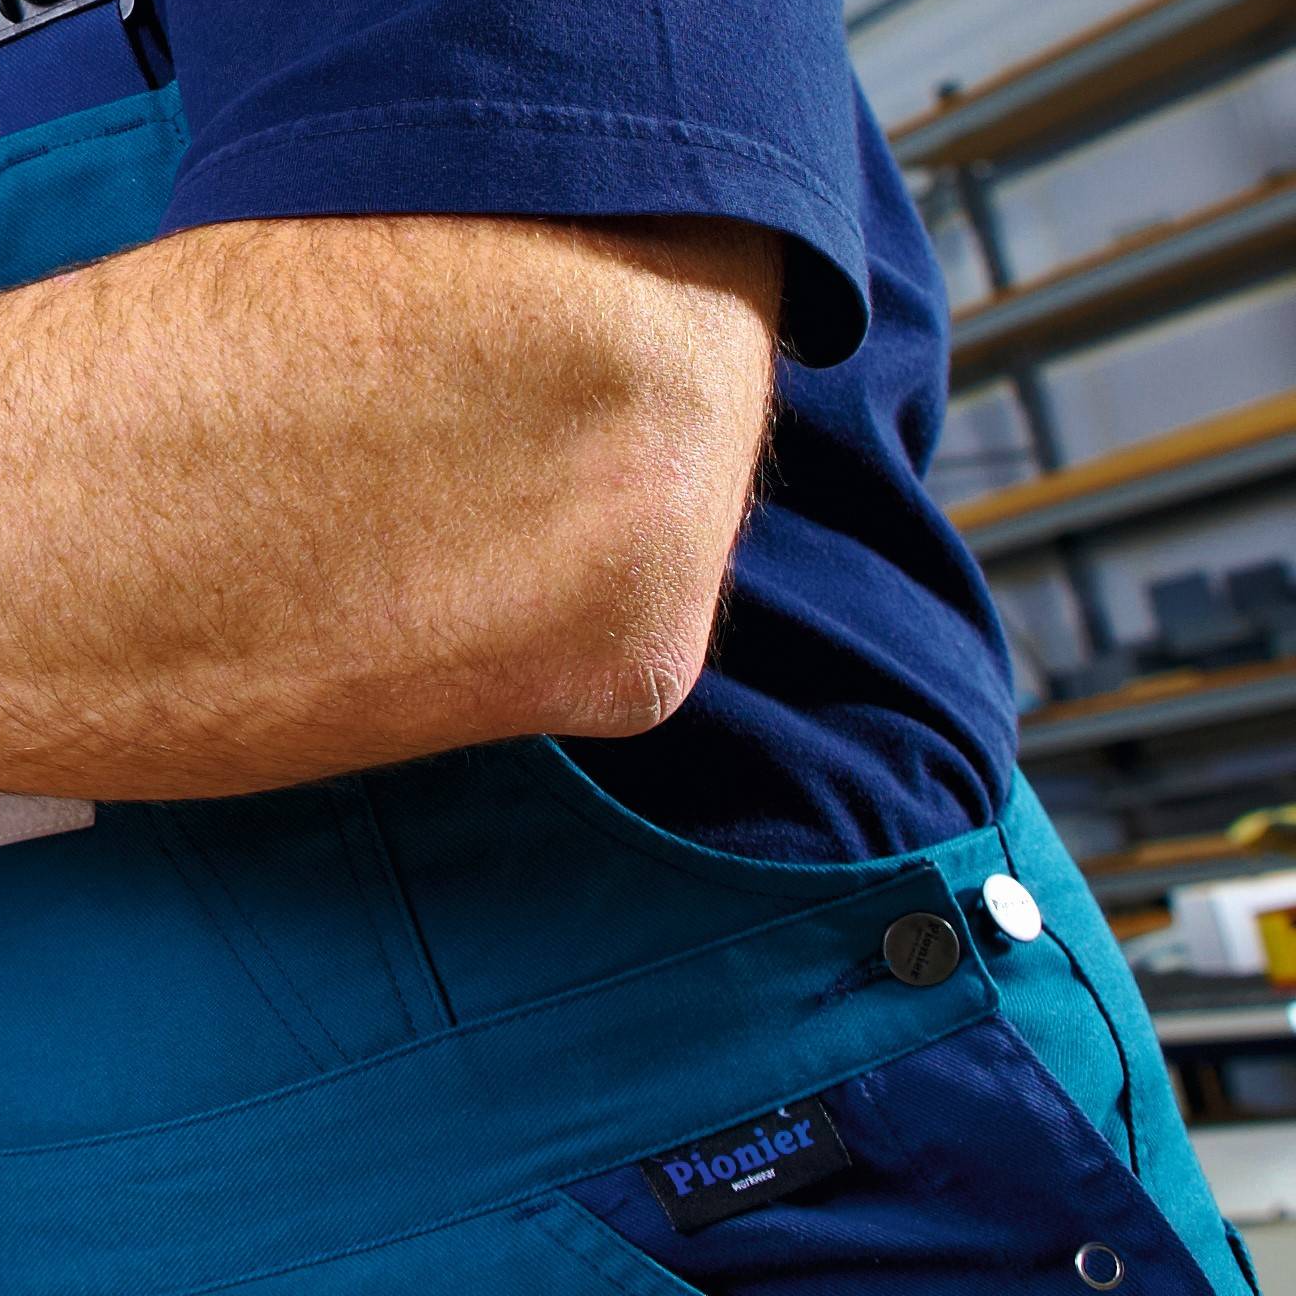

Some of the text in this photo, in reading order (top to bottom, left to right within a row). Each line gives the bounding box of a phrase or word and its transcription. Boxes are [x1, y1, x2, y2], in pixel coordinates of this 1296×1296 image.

[910, 920, 943, 980] Pionier
[664, 1119, 816, 1197] Pionier
[731, 1168, 777, 1192] workwear
